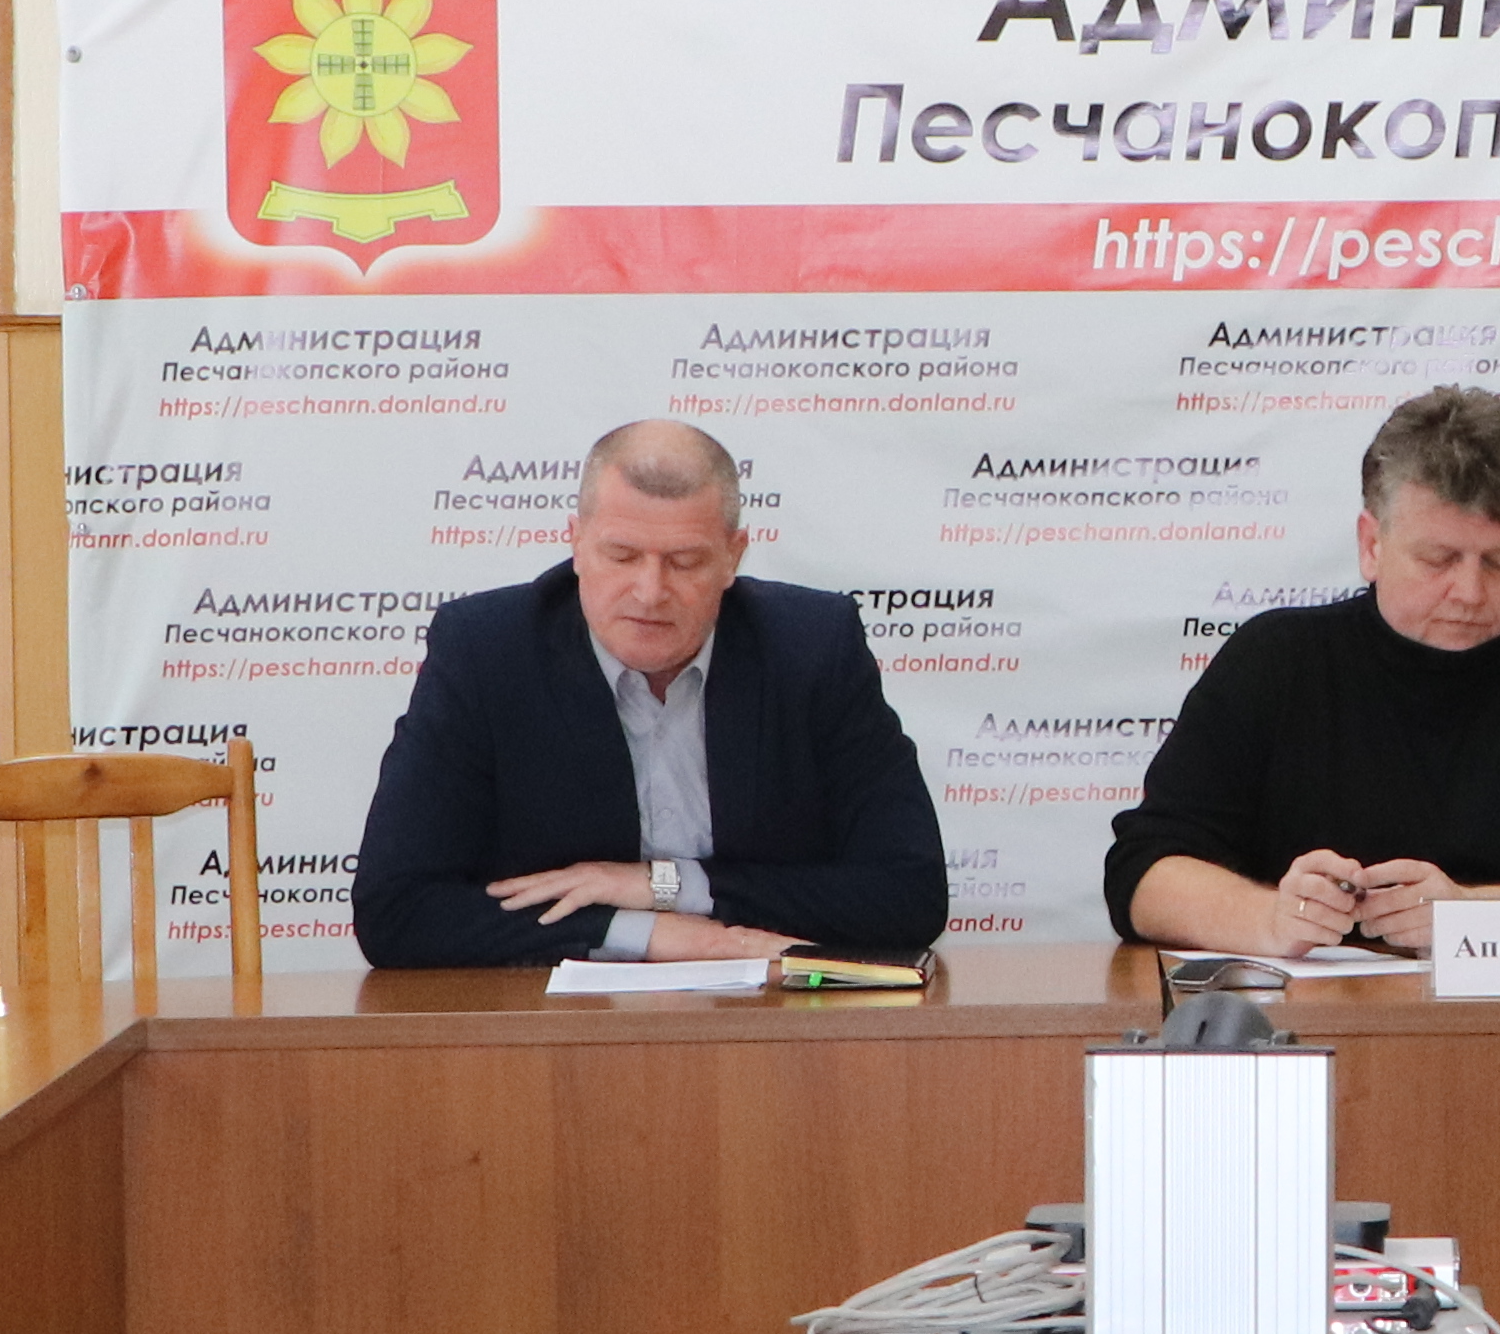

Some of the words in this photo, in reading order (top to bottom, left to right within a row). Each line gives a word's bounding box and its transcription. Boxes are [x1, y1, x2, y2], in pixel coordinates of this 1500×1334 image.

[190, 326, 482, 355] Администрация
[700, 324, 991, 354] Администрация
[162, 362, 400, 383] Песчанокопского
[409, 359, 509, 382] района
[670, 359, 911, 379] Песчанокопского
[918, 356, 1018, 381] района
[159, 396, 507, 420] https://peschanrn.donland.ru
[669, 394, 1016, 416] https://peschanrn.donland.ru
[171, 491, 270, 517] района
[943, 487, 1181, 508] Песчанокопского
[940, 522, 1285, 545] https://peschanrn.donland.ru
[165, 623, 404, 644] Песчанокопского
[923, 617, 1022, 642] района
